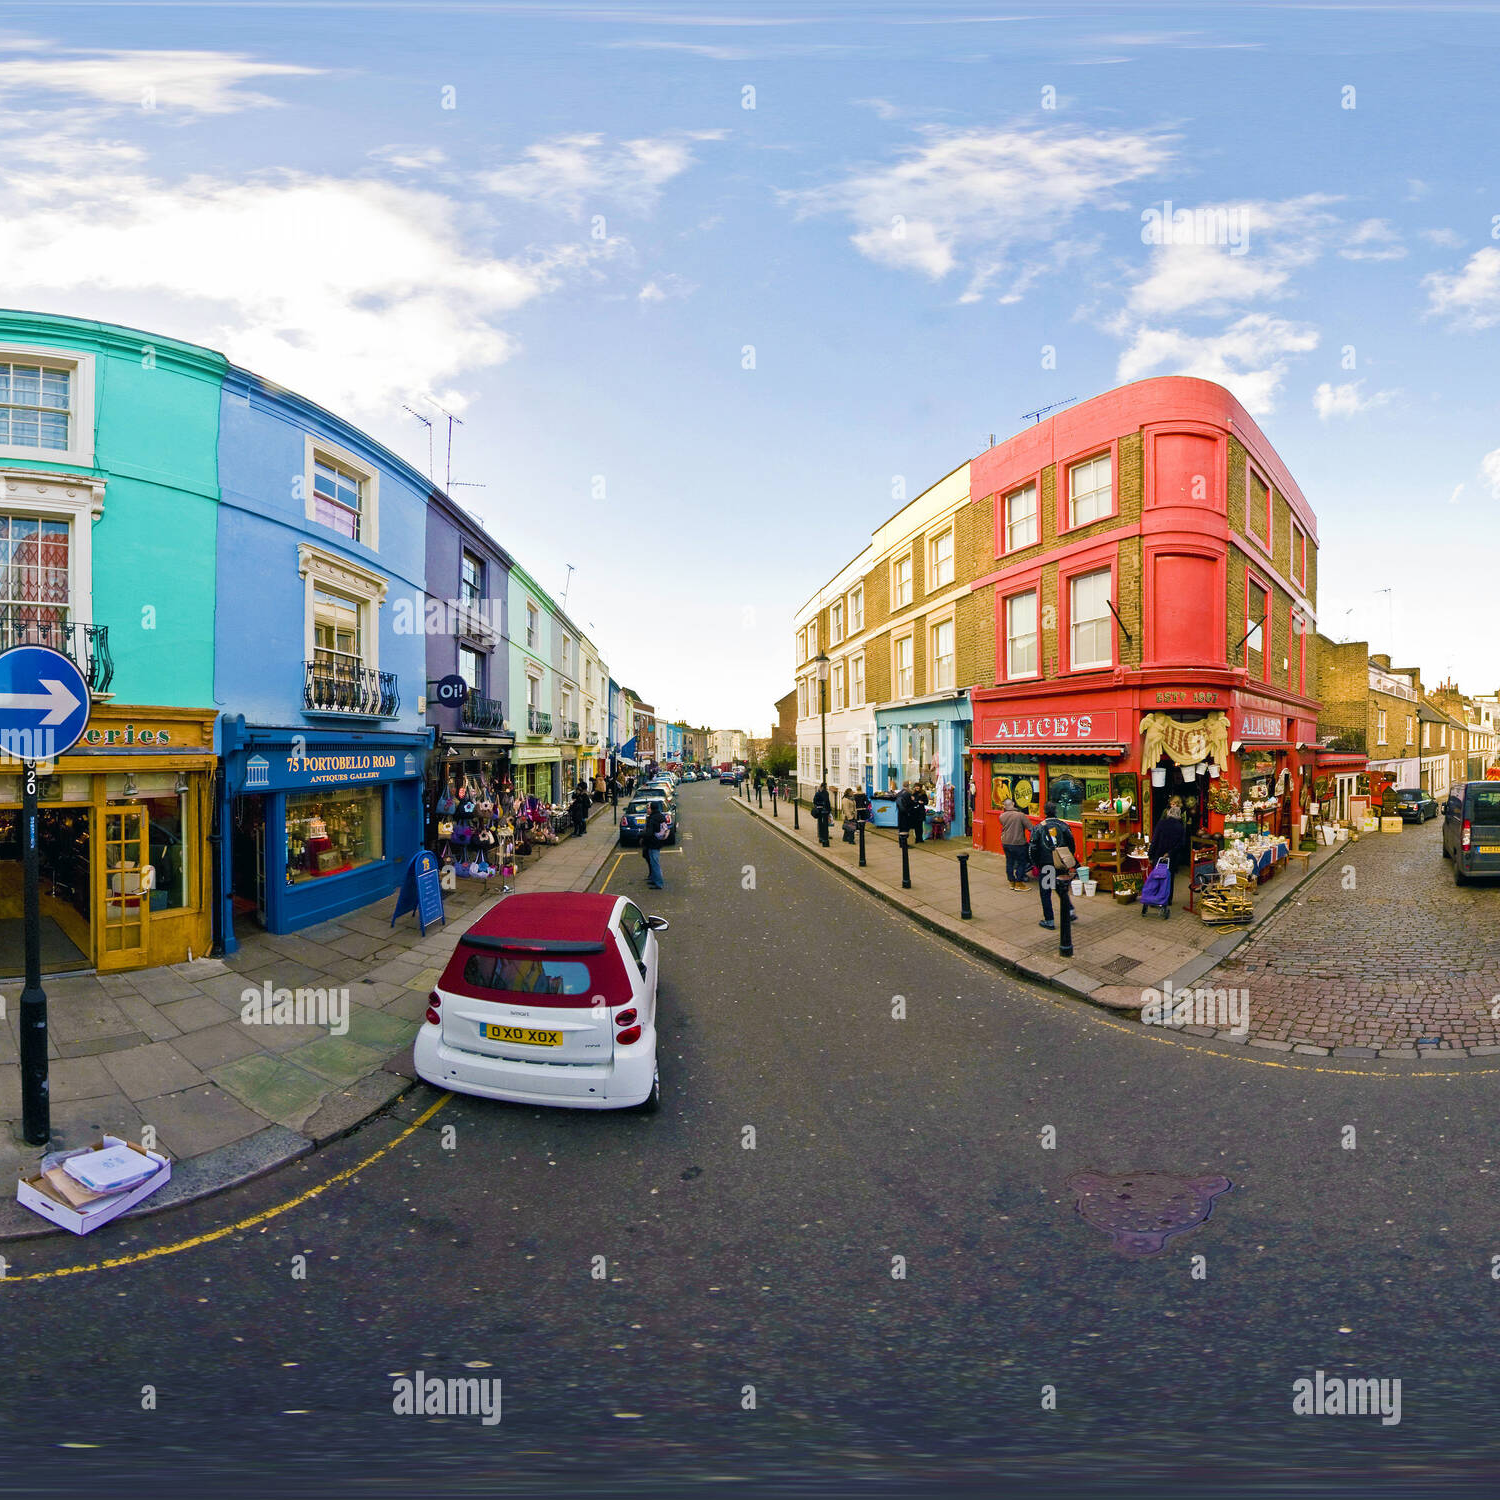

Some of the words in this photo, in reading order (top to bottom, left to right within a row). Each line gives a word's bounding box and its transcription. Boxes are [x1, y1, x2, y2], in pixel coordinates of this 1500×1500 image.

[440, 684, 463, 699] Oi!
[81, 724, 171, 746] eries
[995, 715, 1093, 738] ALICE'S
[286, 757, 299, 772] 75
[303, 755, 370, 772] PORTOBELLO
[372, 755, 396, 768] ROAD
[310, 774, 348, 783] ANTIQUES
[349, 771, 380, 780] GALLERY
